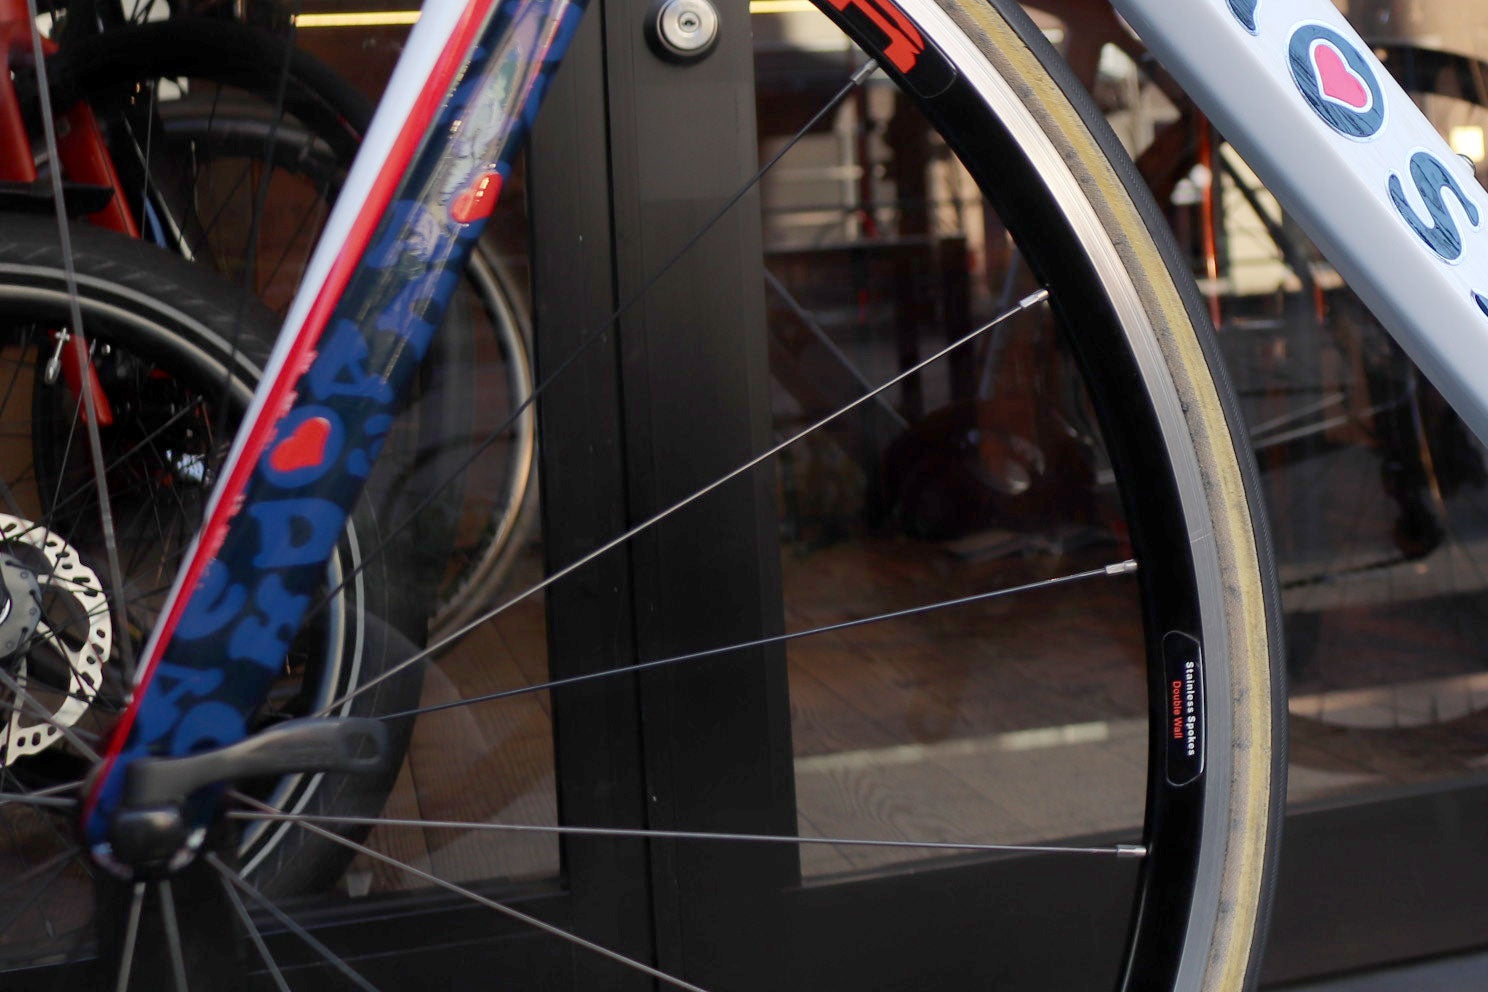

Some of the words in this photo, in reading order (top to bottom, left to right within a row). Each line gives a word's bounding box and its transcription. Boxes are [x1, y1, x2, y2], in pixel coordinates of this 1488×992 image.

[1171, 680, 1183, 715] Double
[1184, 661, 1196, 714] Stainless
[1173, 716, 1183, 739] Wall
[1185, 715, 1197, 756] Spokes
